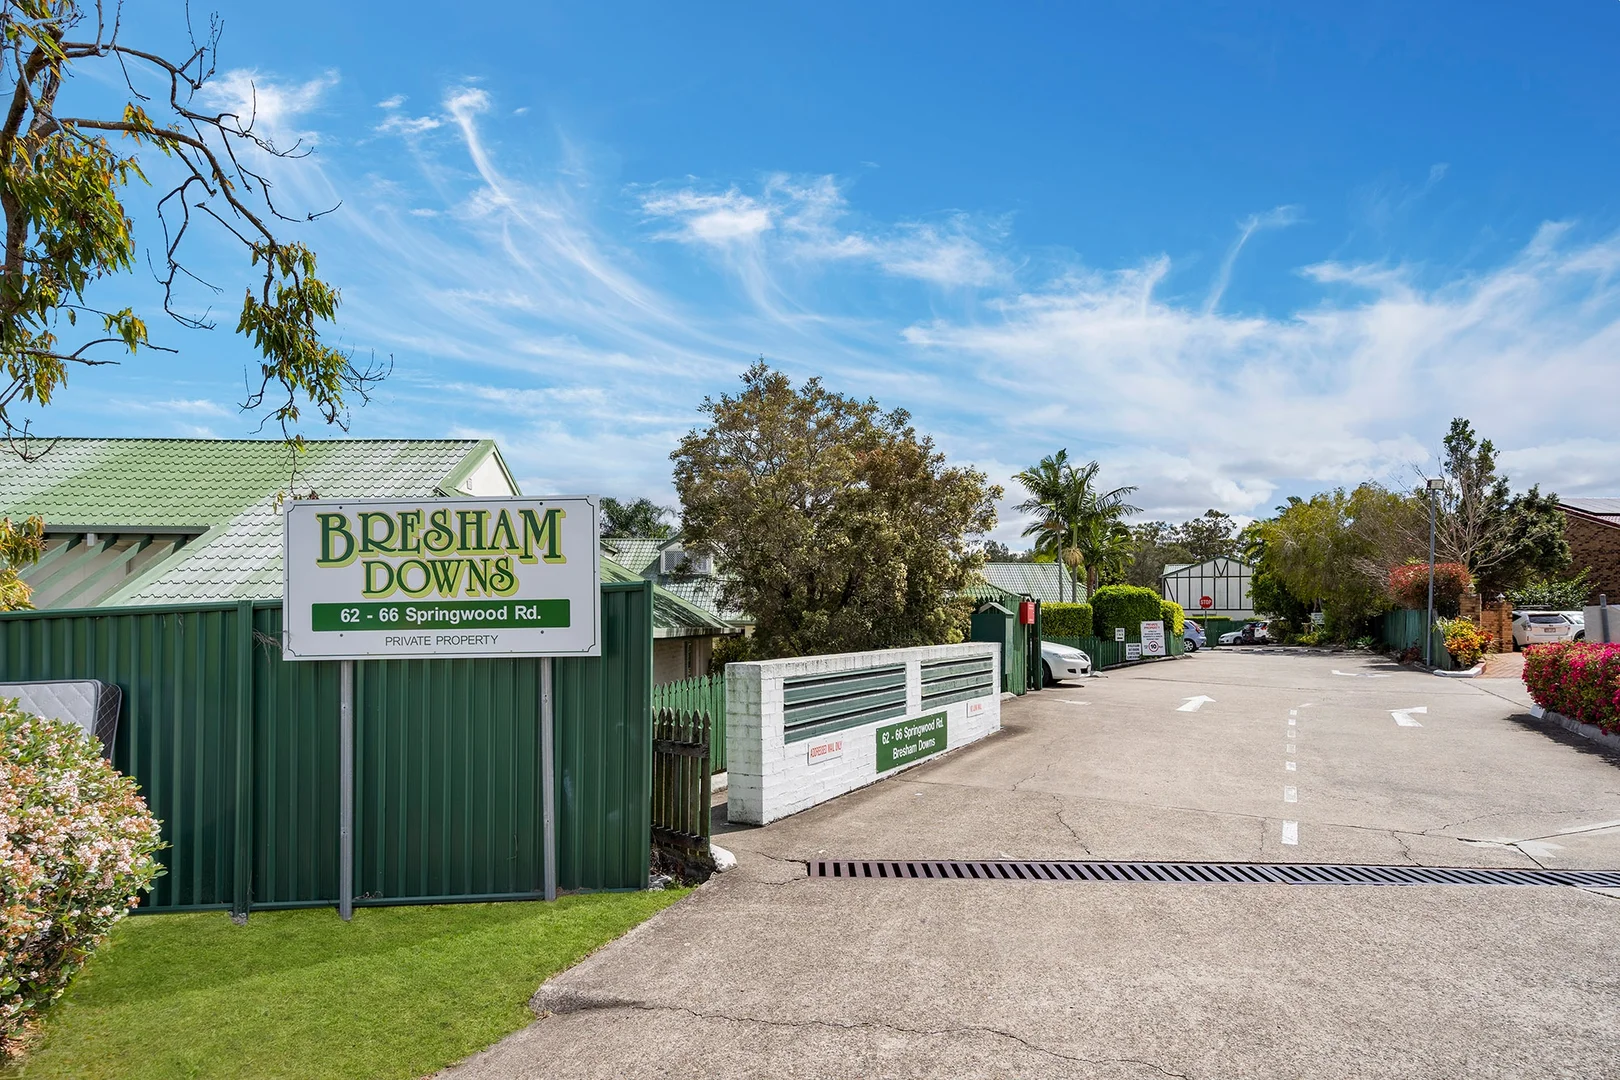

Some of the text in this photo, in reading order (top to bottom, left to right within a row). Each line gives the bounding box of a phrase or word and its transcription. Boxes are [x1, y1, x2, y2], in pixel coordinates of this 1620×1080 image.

[315, 508, 566, 568] BRESHAM
[361, 556, 520, 599] DOWNS
[340, 608, 360, 623] 62
[378, 607, 399, 622] 66
[405, 606, 508, 625] Springwood
[514, 605, 542, 620] Rd.
[385, 634, 499, 647] PRIVATE PROPERTY
[881, 731, 890, 745] 62
[895, 727, 903, 741] 66
[903, 719, 935, 740] Springwood
[935, 716, 944, 730] Rd.
[892, 737, 936, 760] Bresham Downs
